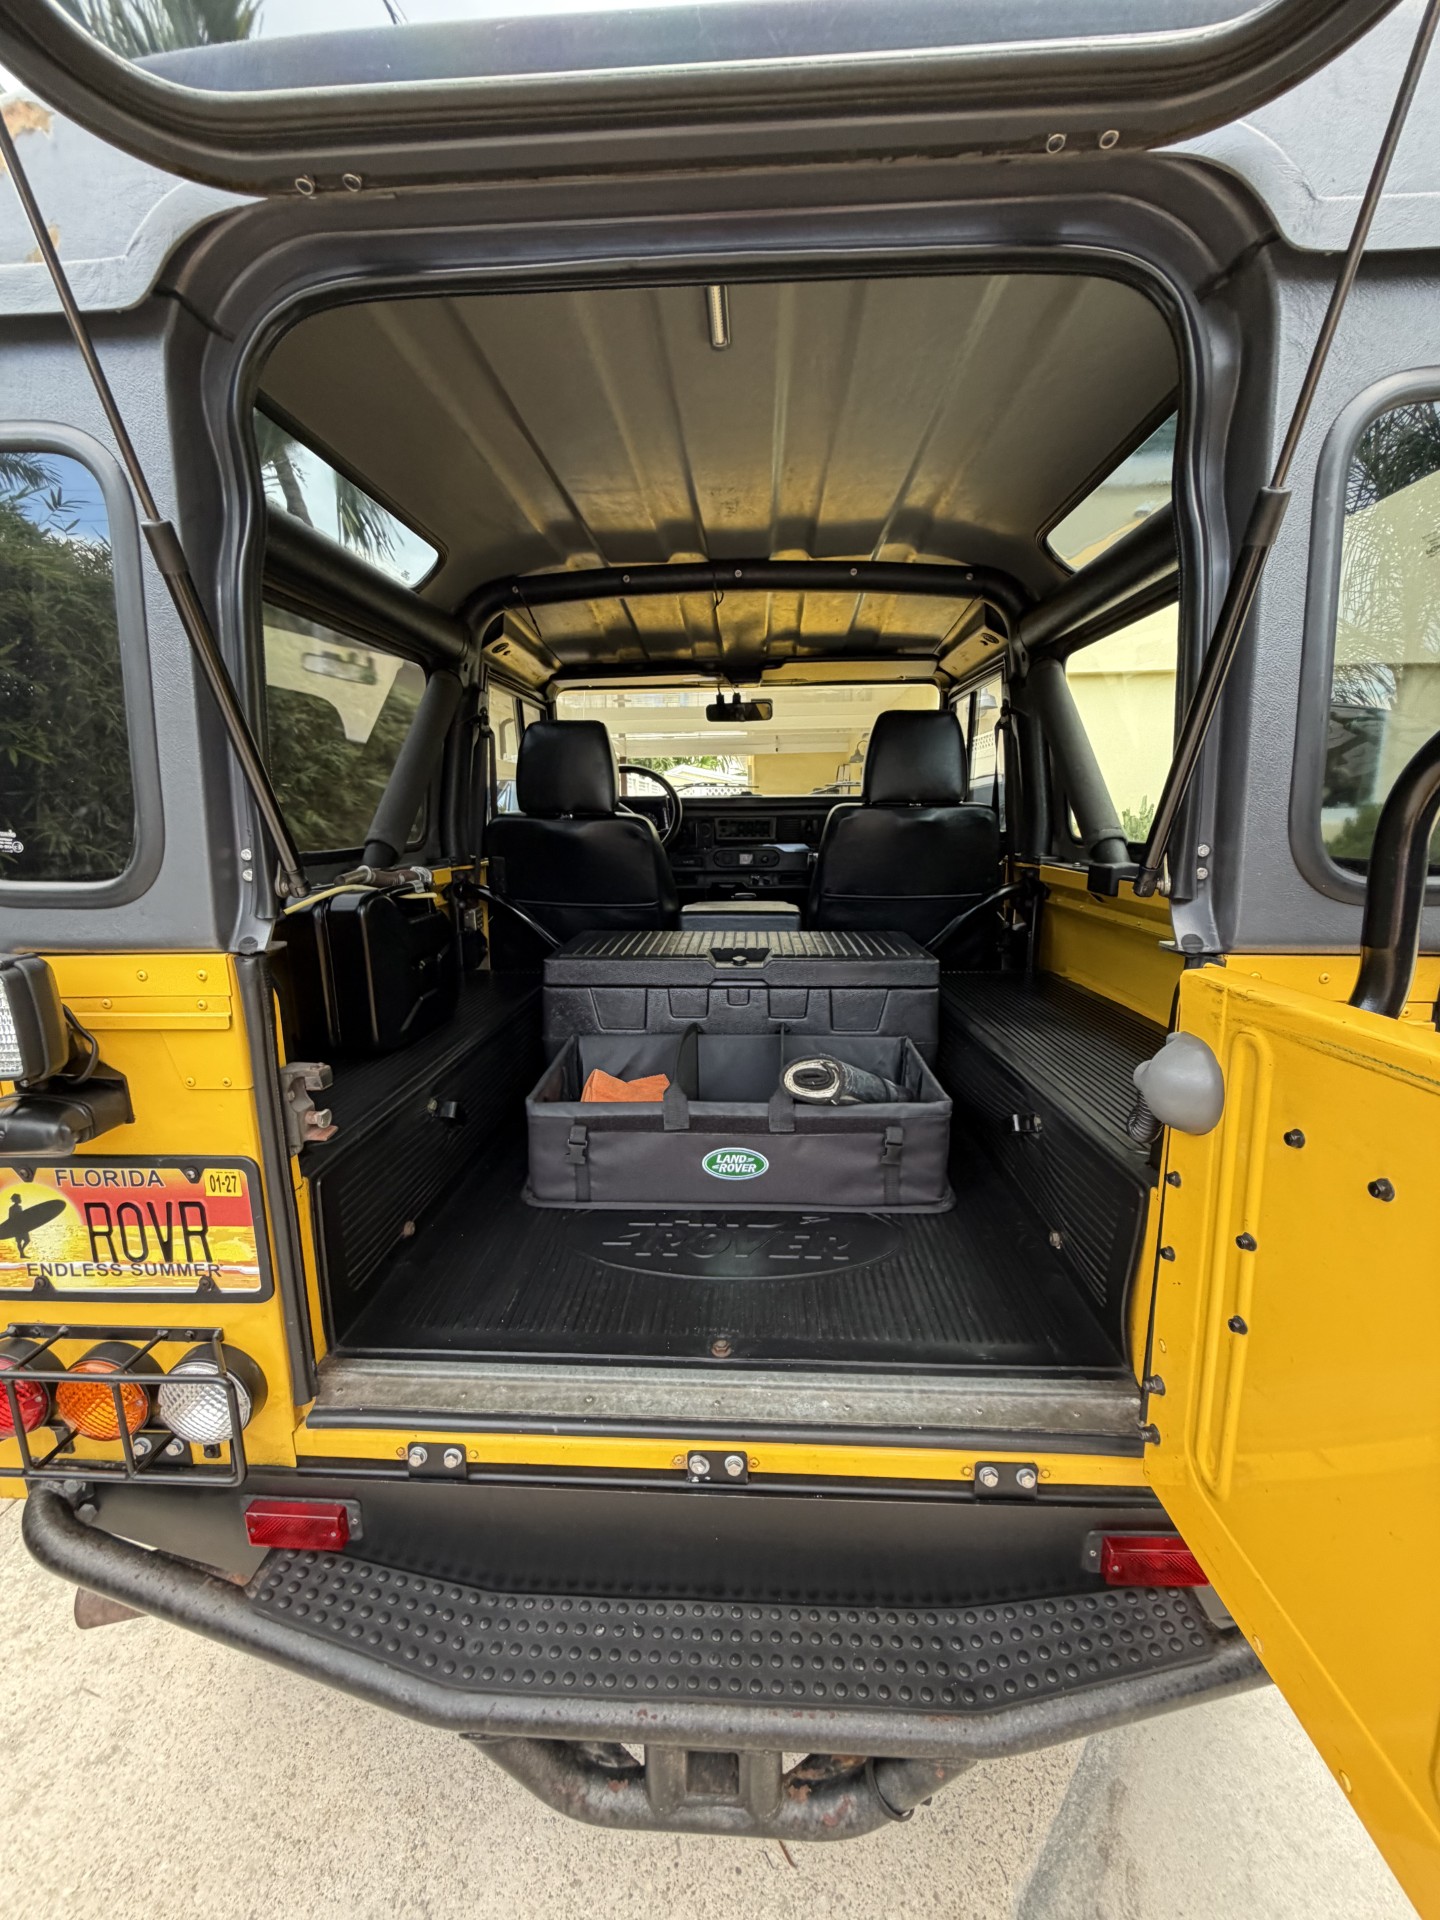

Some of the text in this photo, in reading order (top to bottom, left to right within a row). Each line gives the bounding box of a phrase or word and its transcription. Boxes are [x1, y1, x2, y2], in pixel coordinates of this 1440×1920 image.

[716, 1154, 747, 1163] LAND
[718, 1163, 757, 1173] ROVER
[54, 1169, 166, 1188] FLORIDA
[209, 1174, 237, 1194] 01-27
[84, 1201, 213, 1263] ROVR
[27, 1263, 222, 1278] ENDLESS SUMMER
